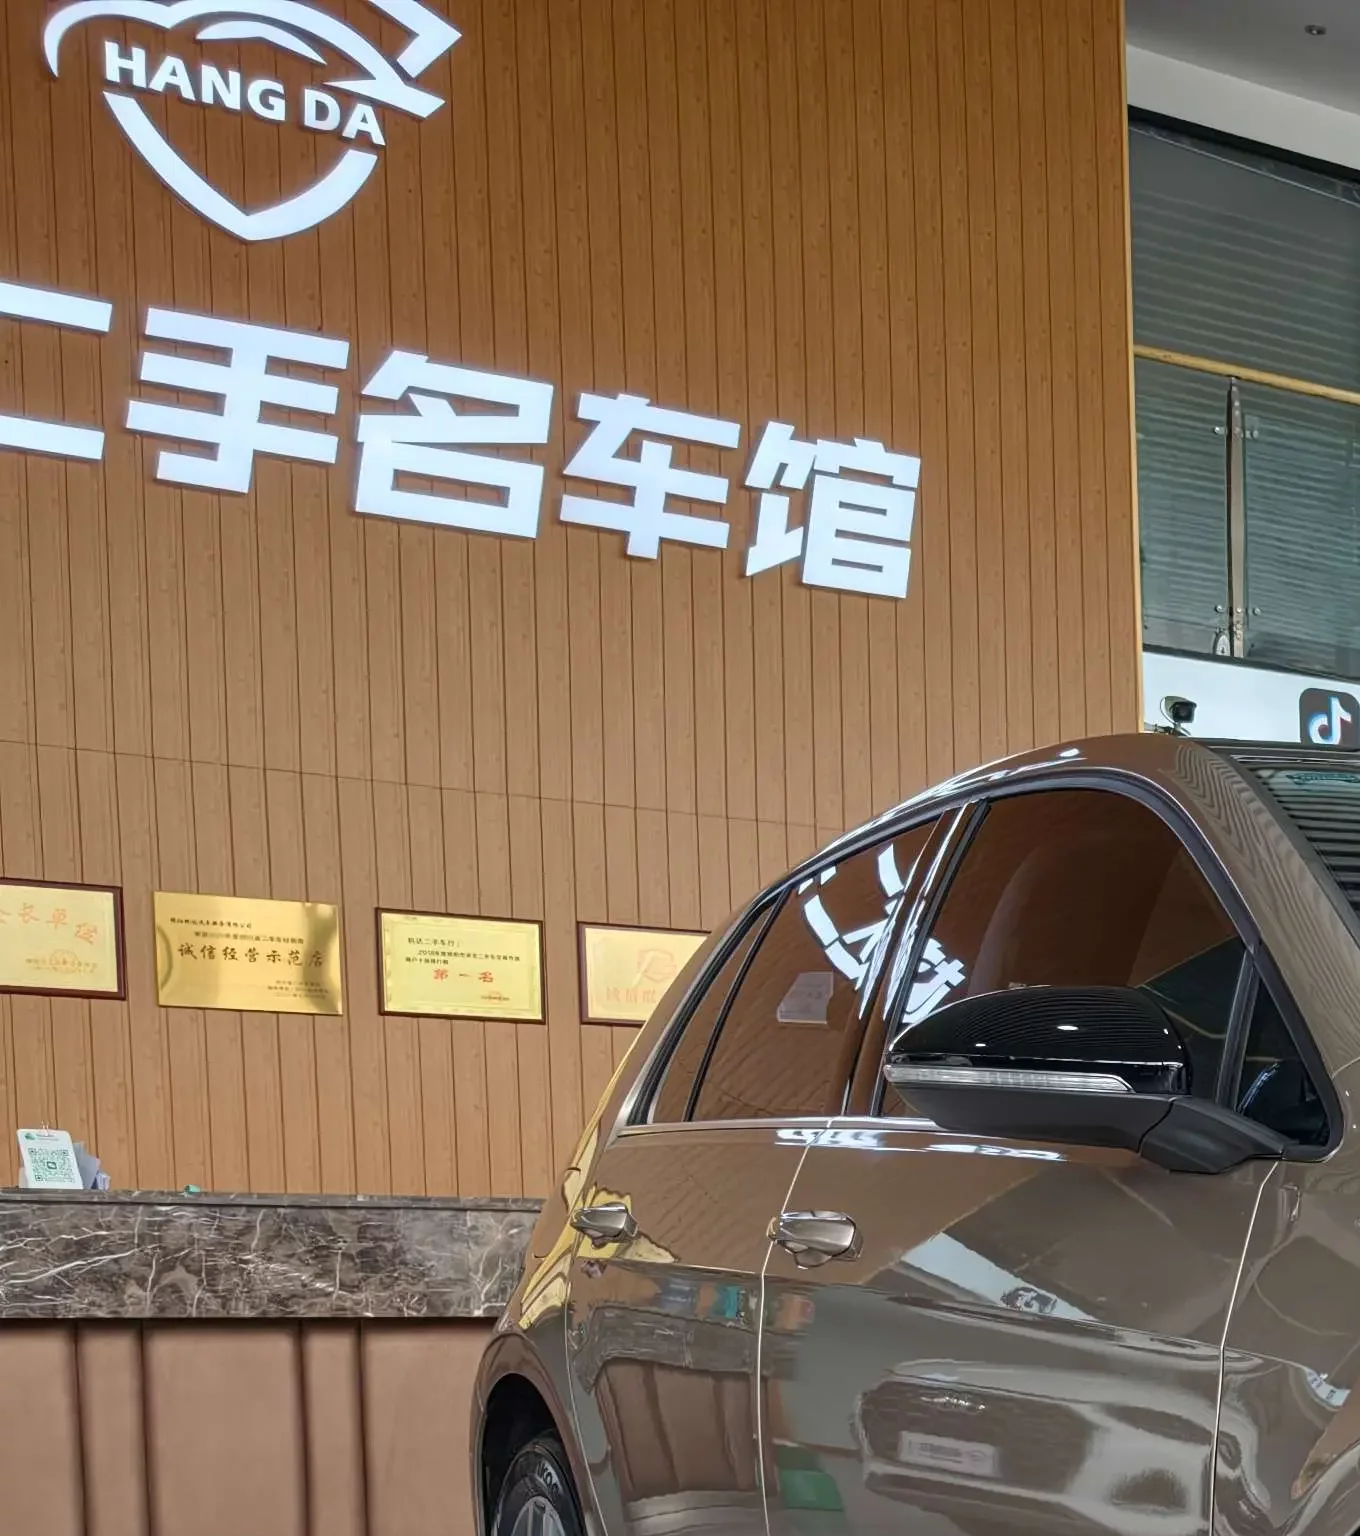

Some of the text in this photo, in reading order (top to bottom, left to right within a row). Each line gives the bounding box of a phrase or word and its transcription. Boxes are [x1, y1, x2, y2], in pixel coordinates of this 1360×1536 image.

[103, 40, 386, 146] HANG DA
[178, 942, 325, 968] 诚信经营示范店
